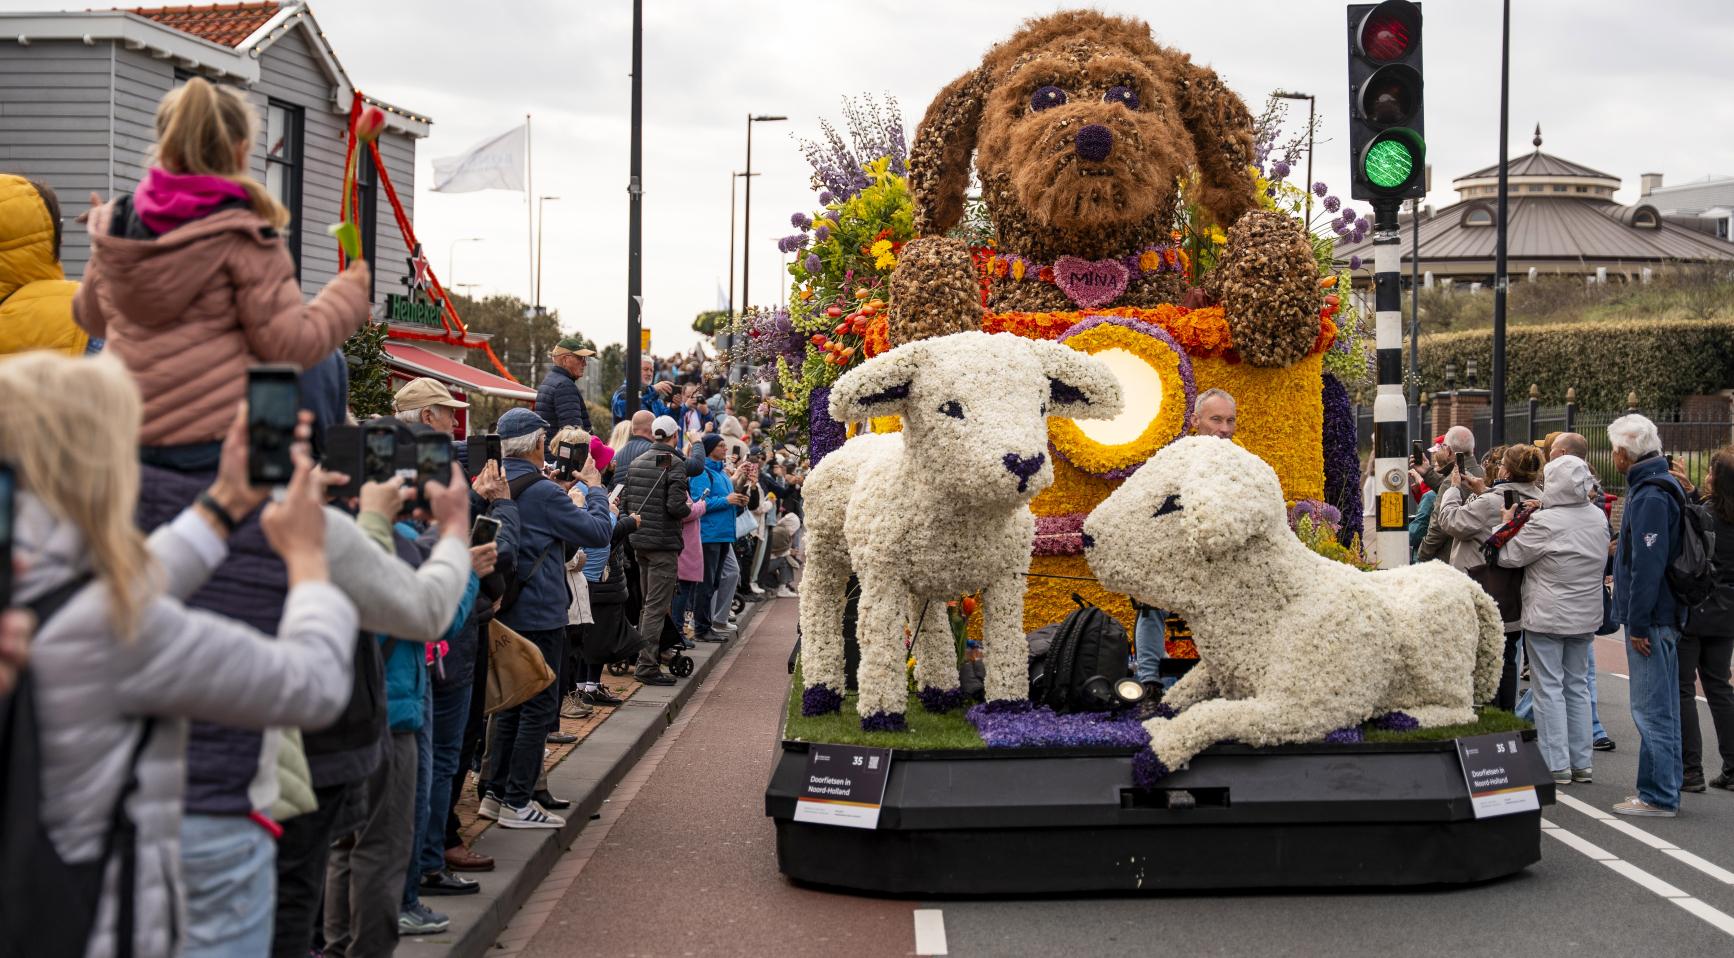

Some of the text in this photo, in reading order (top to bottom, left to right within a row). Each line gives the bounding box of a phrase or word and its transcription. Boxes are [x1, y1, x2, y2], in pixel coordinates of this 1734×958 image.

[1070, 271, 1117, 288] MINA
[1496, 743, 1506, 753] 35
[852, 755, 864, 766] 35
[810, 775, 851, 786] Doorfietsen in
[808, 785, 851, 796] Noord-Holland
